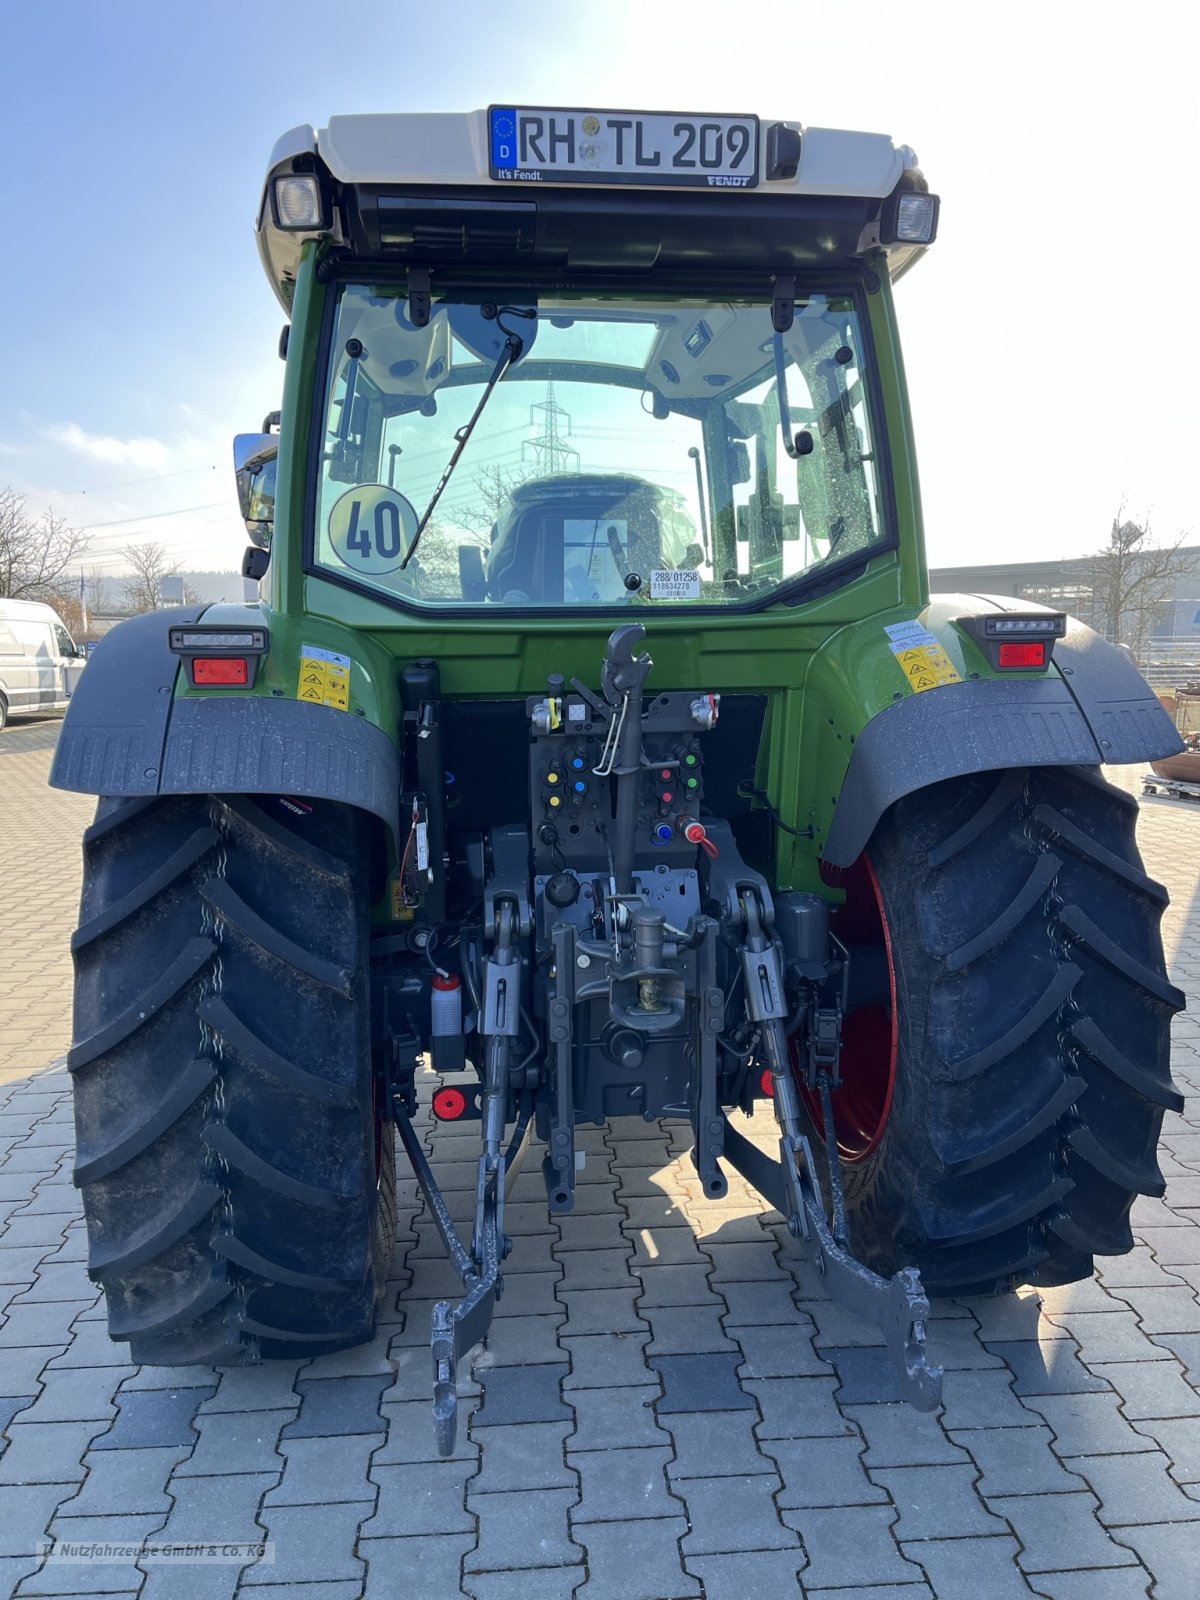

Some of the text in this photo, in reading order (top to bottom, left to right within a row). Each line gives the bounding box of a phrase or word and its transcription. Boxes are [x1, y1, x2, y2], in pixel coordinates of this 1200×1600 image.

[520, 117, 750, 169] RH TL 209
[500, 145, 510, 159] D
[498, 169, 543, 181] It's Fendt.
[707, 175, 751, 187] FENDT
[346, 500, 401, 559] 40
